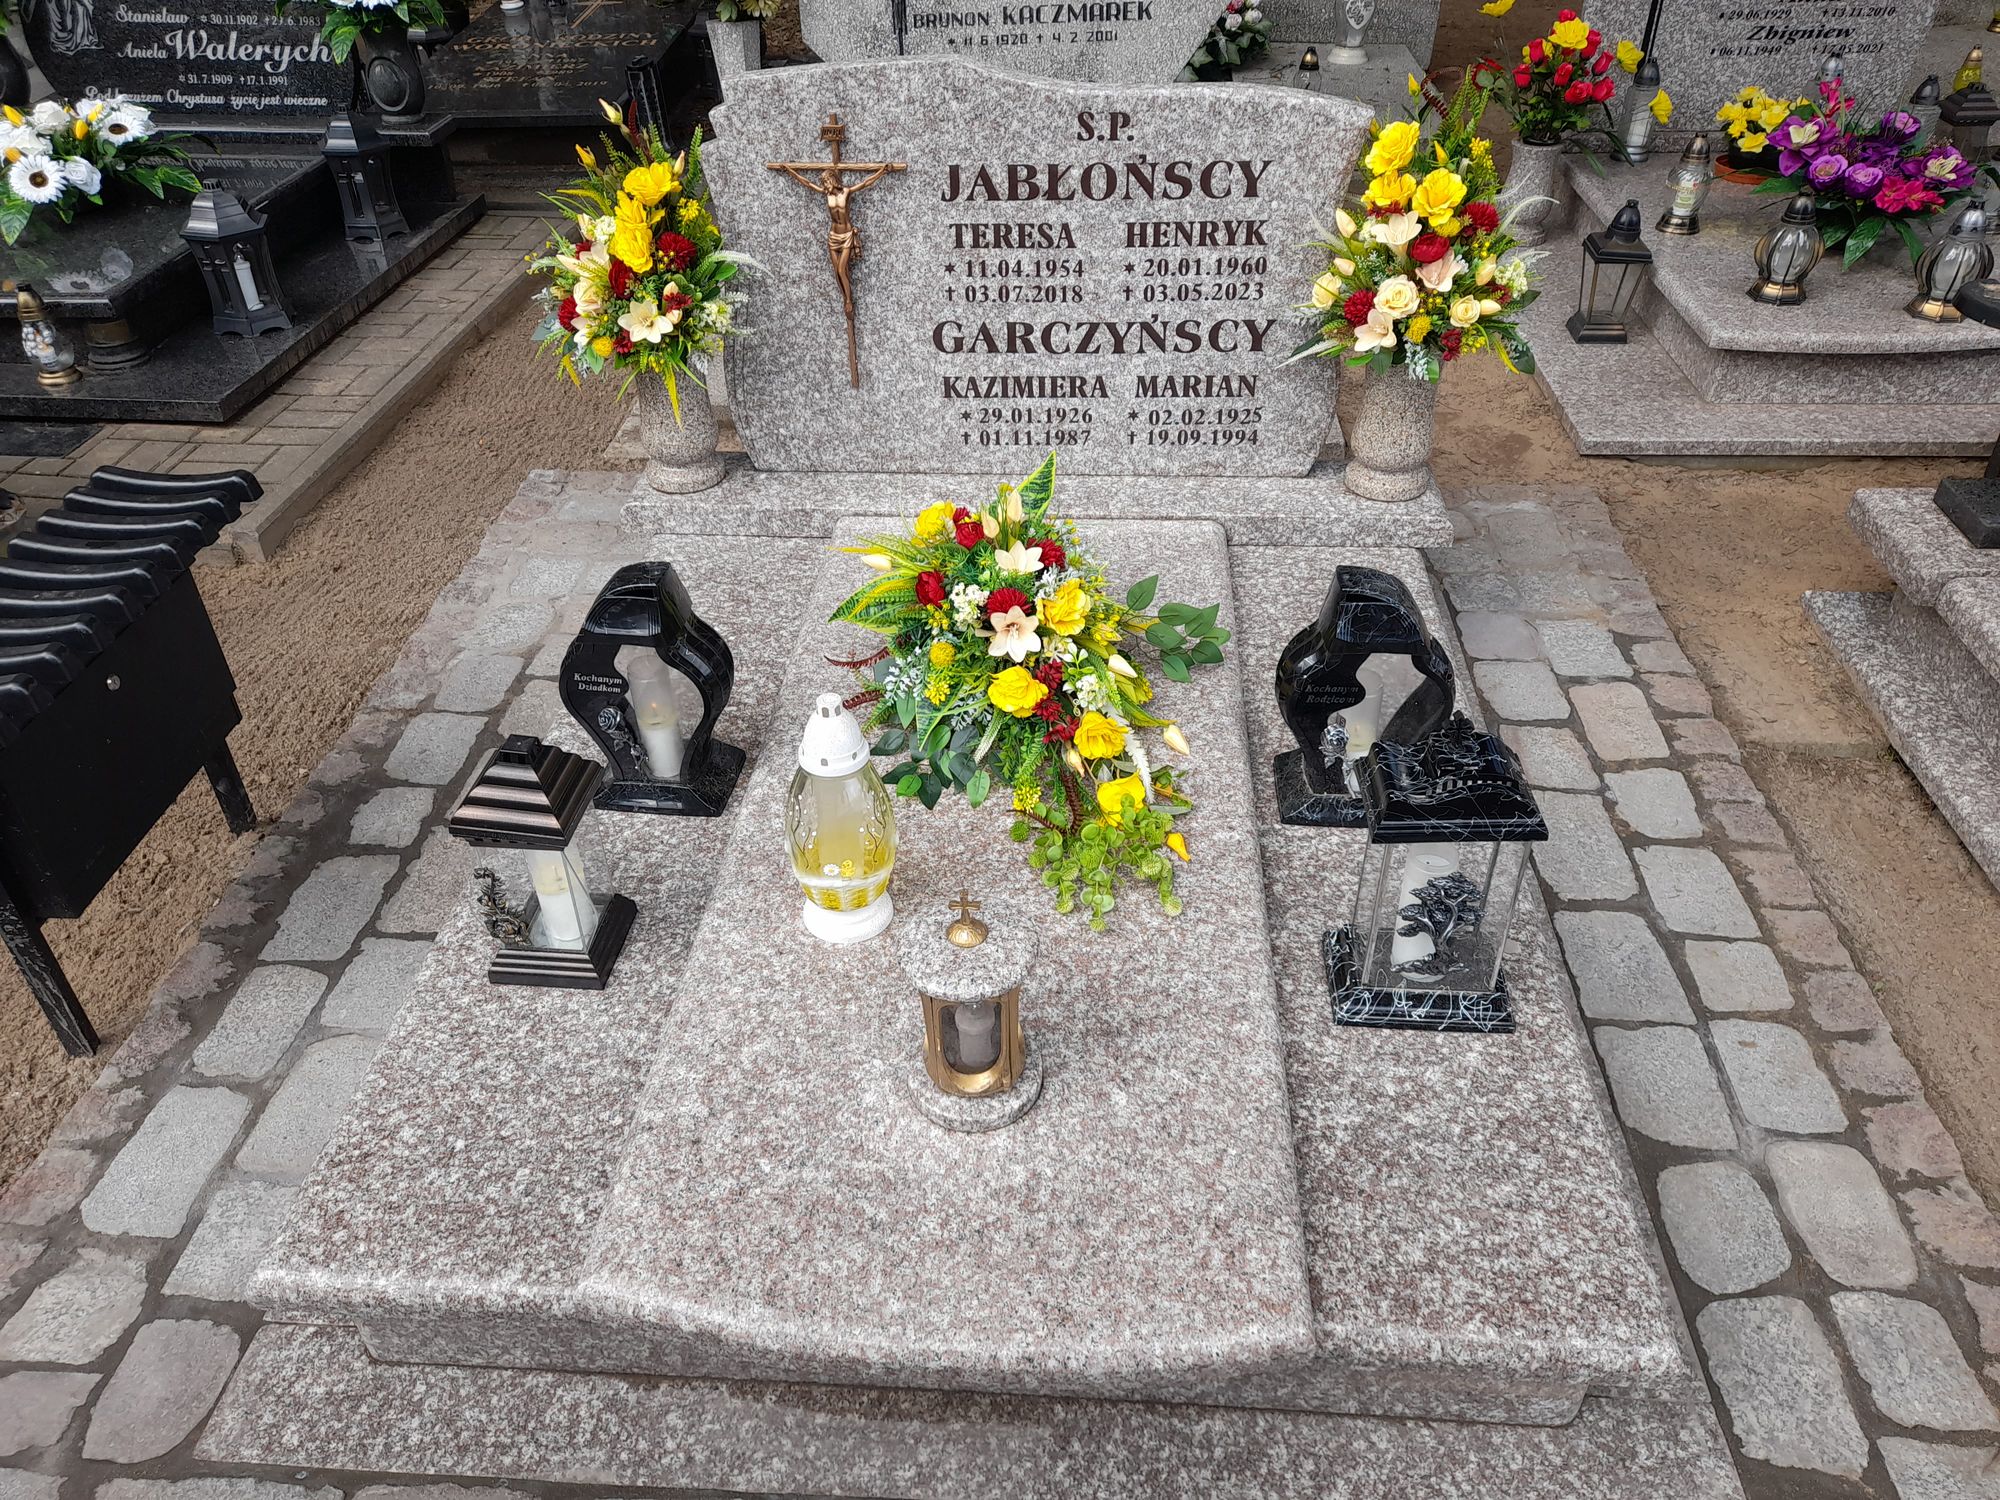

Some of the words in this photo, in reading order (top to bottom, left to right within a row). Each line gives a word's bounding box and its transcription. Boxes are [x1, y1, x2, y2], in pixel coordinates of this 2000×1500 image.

[210, 14, 258, 25] 30.11.1902
[912, 12, 990, 29] BRUNON
[1002, 1, 1153, 25] KACZMAREK
[1831, 6, 1896, 18] 13.11.2010
[1086, 30, 1118, 43] 2001
[1746, 24, 1856, 45] Zbigniew
[117, 41, 168, 59] Aniela
[164, 29, 332, 74] Walerych
[187, 74, 233, 85] 31.7.1909
[246, 75, 288, 86] 17.1.1991
[166, 89, 225, 109] Chrystusa
[283, 94, 328, 106] wieczne
[940, 154, 1273, 202] JABŁOŃSCY
[949, 222, 1077, 249] TERESA
[1124, 220, 1268, 248] HENRYK
[965, 259, 1085, 278] 11.04.1954
[1143, 257, 1267, 277] 20.01.1960
[964, 285, 1083, 303] 03.07.2018
[1143, 282, 1264, 302] 03.05.2023
[932, 314, 1277, 355] GARCZYŃSCY
[942, 375, 1109, 399] KAZIMIERA
[1135, 375, 1258, 398] MARIAN
[979, 408, 1093, 424] 29.01.1926
[1149, 407, 1263, 425] 02.02.1925
[979, 431, 1091, 447] 01.11.1987
[1147, 430, 1259, 446] 19.09.1994
[573, 673, 622, 684] Kochanym
[578, 682, 621, 693] Dziadkom
[1305, 684, 1359, 694] Kochanym
